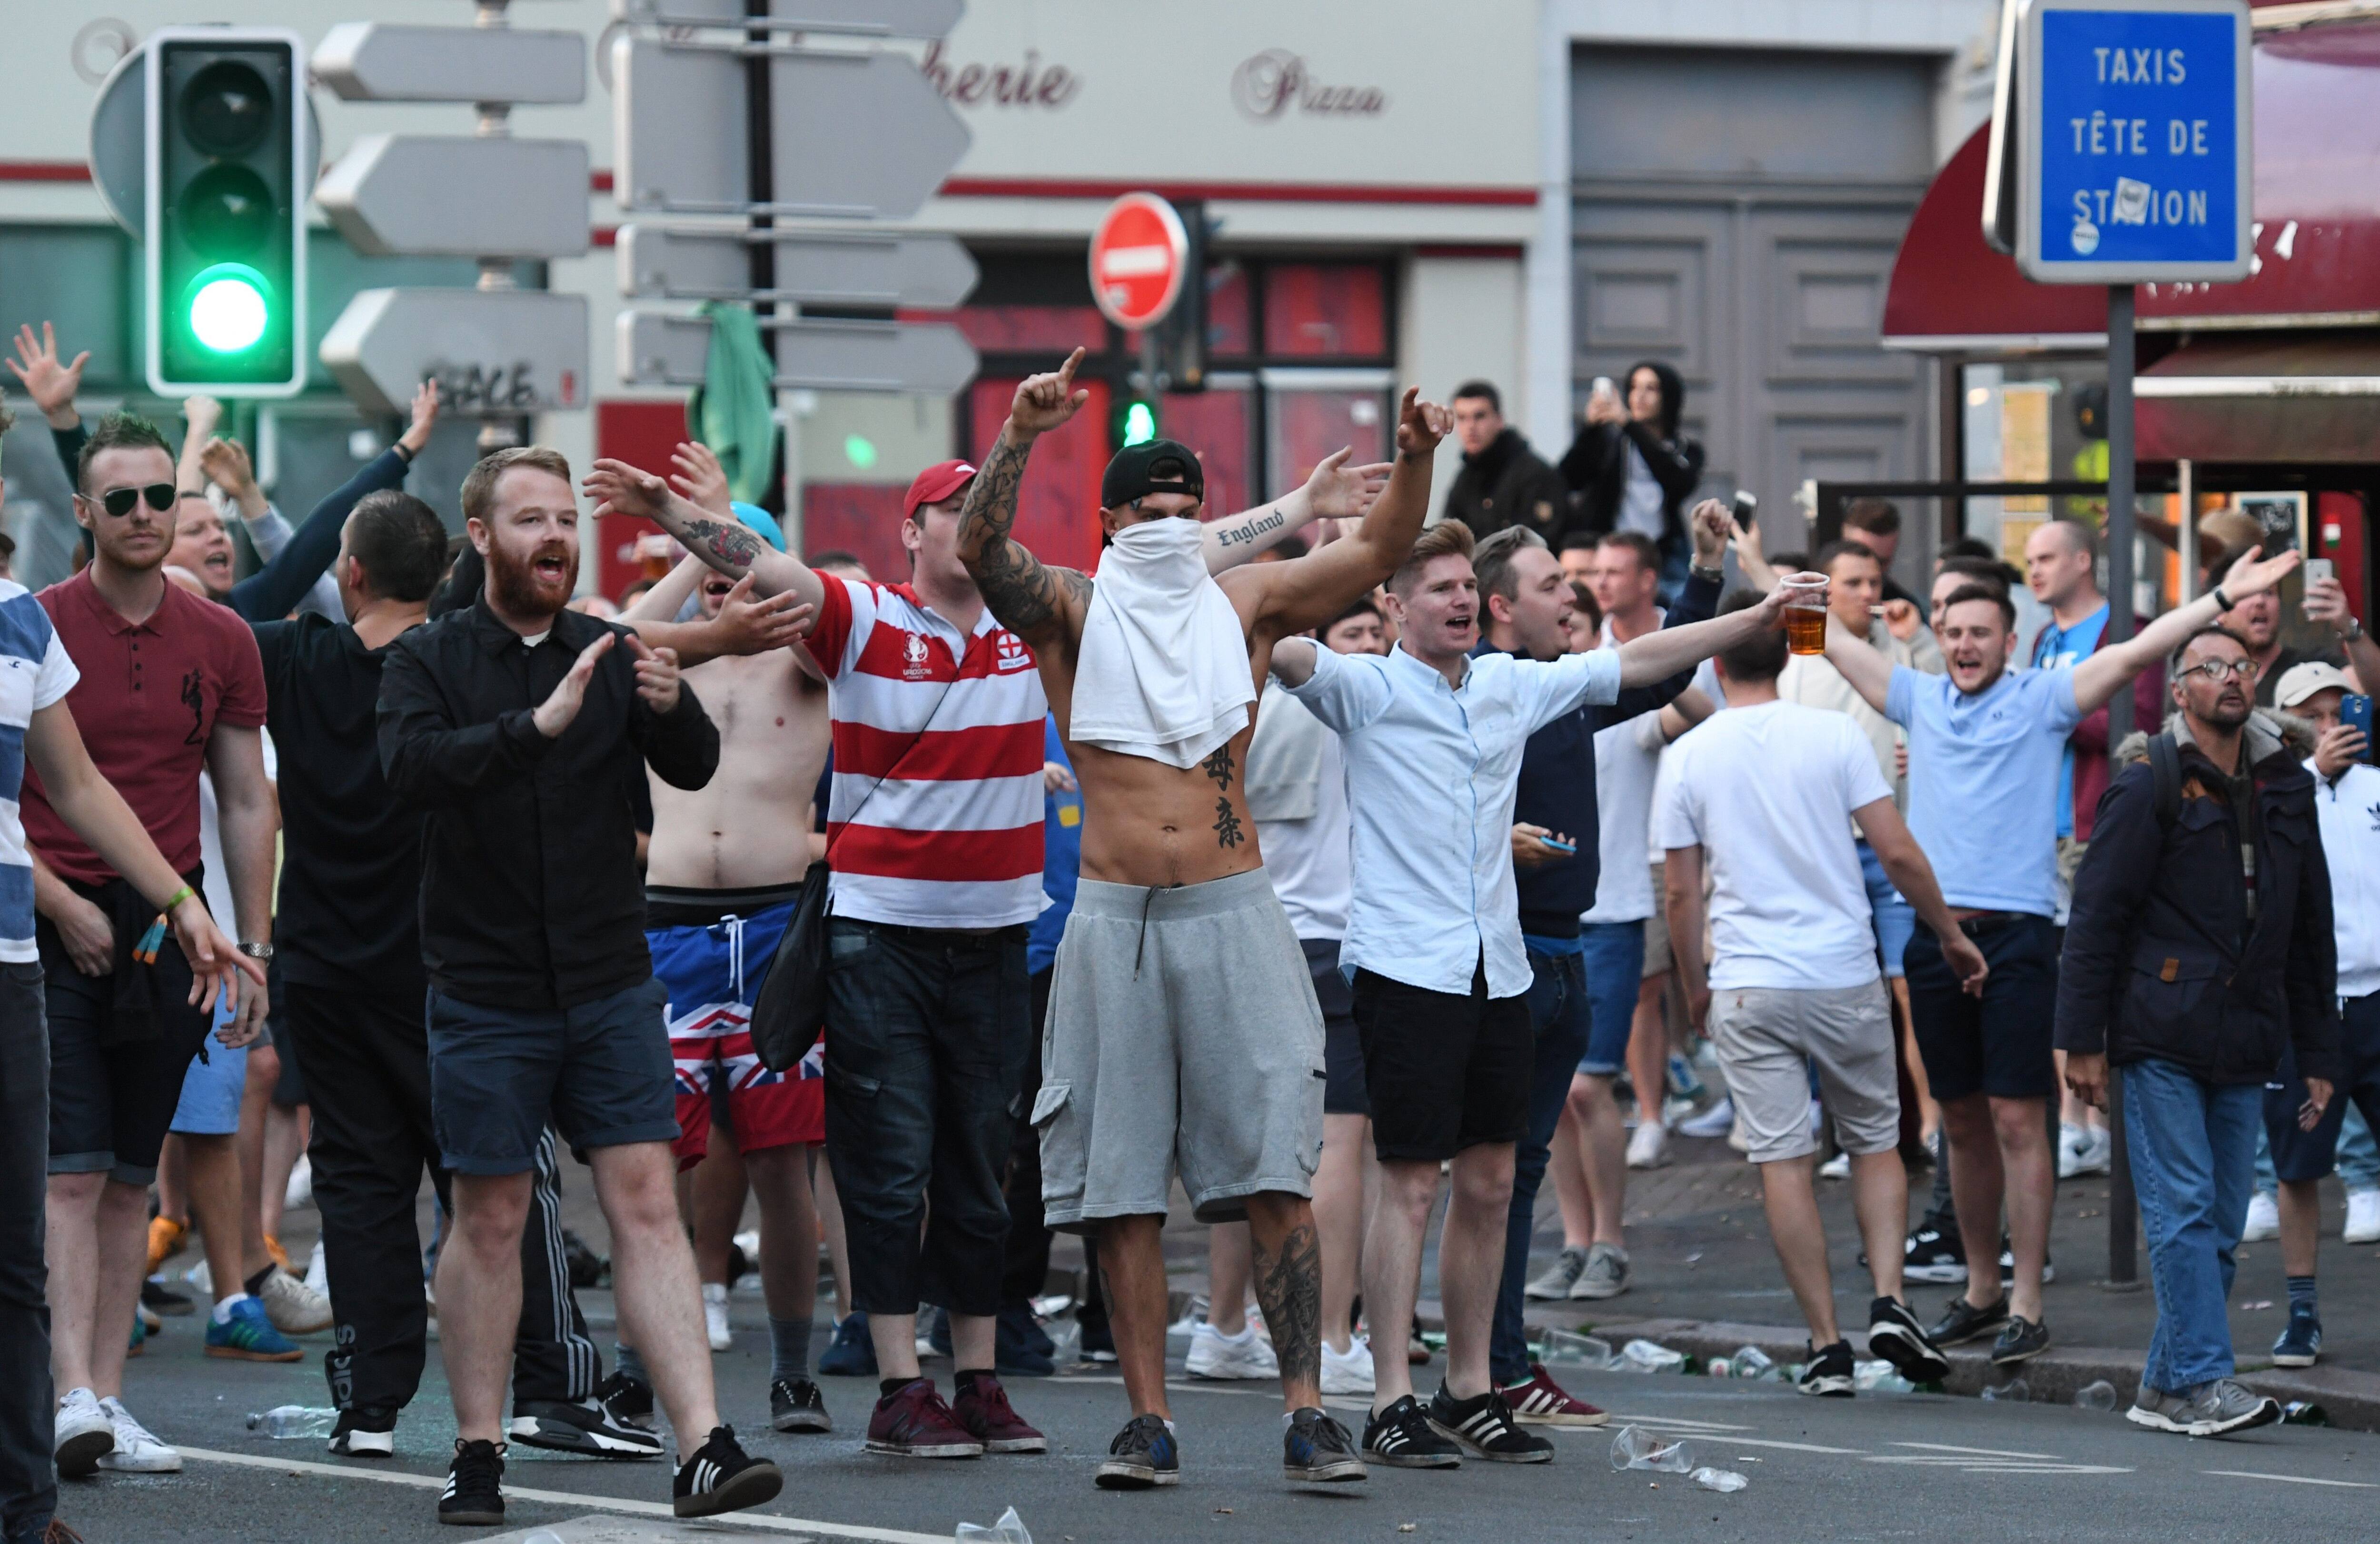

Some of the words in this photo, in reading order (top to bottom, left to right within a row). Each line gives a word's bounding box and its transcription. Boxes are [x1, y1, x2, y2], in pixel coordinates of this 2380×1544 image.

[922, 40, 1086, 110] herie
[1230, 48, 1389, 125] Pizza
[2094, 48, 2186, 84] TAXIS
[2071, 110, 2148, 155] TÊTE
[2169, 119, 2209, 155] DE
[2073, 189, 2207, 226] STION
[1216, 508, 1284, 546] England
